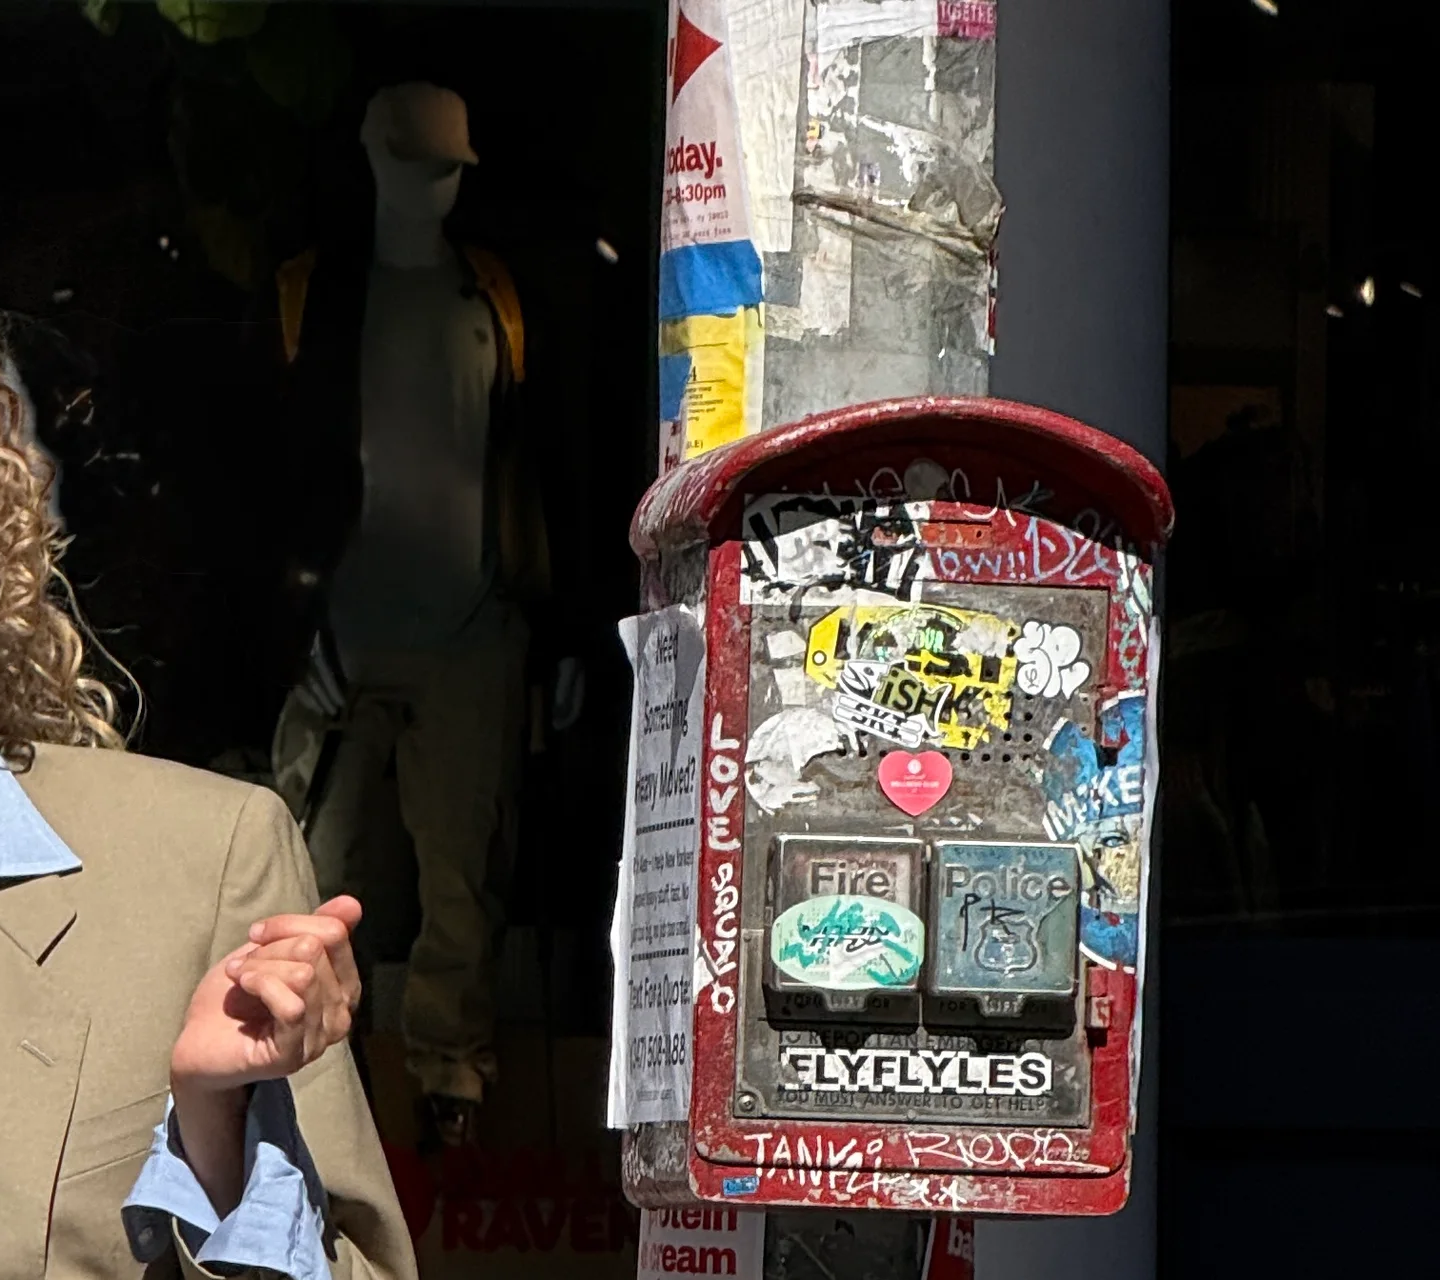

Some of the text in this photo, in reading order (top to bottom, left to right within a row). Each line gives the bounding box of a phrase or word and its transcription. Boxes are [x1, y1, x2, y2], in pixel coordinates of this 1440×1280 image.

[707, 711, 742, 851] LOVE
[811, 857, 890, 896] Fire
[944, 862, 1073, 901] Police
[788, 1053, 1047, 1090] FLYFLYLES
[813, 1091, 853, 1107] MUST
[863, 1093, 931, 1109] ANSWER
[940, 1095, 961, 1109] TO
[969, 1097, 1001, 1110] GET
[1009, 1097, 1045, 1111] HELP
[648, 1207, 738, 1234] otein
